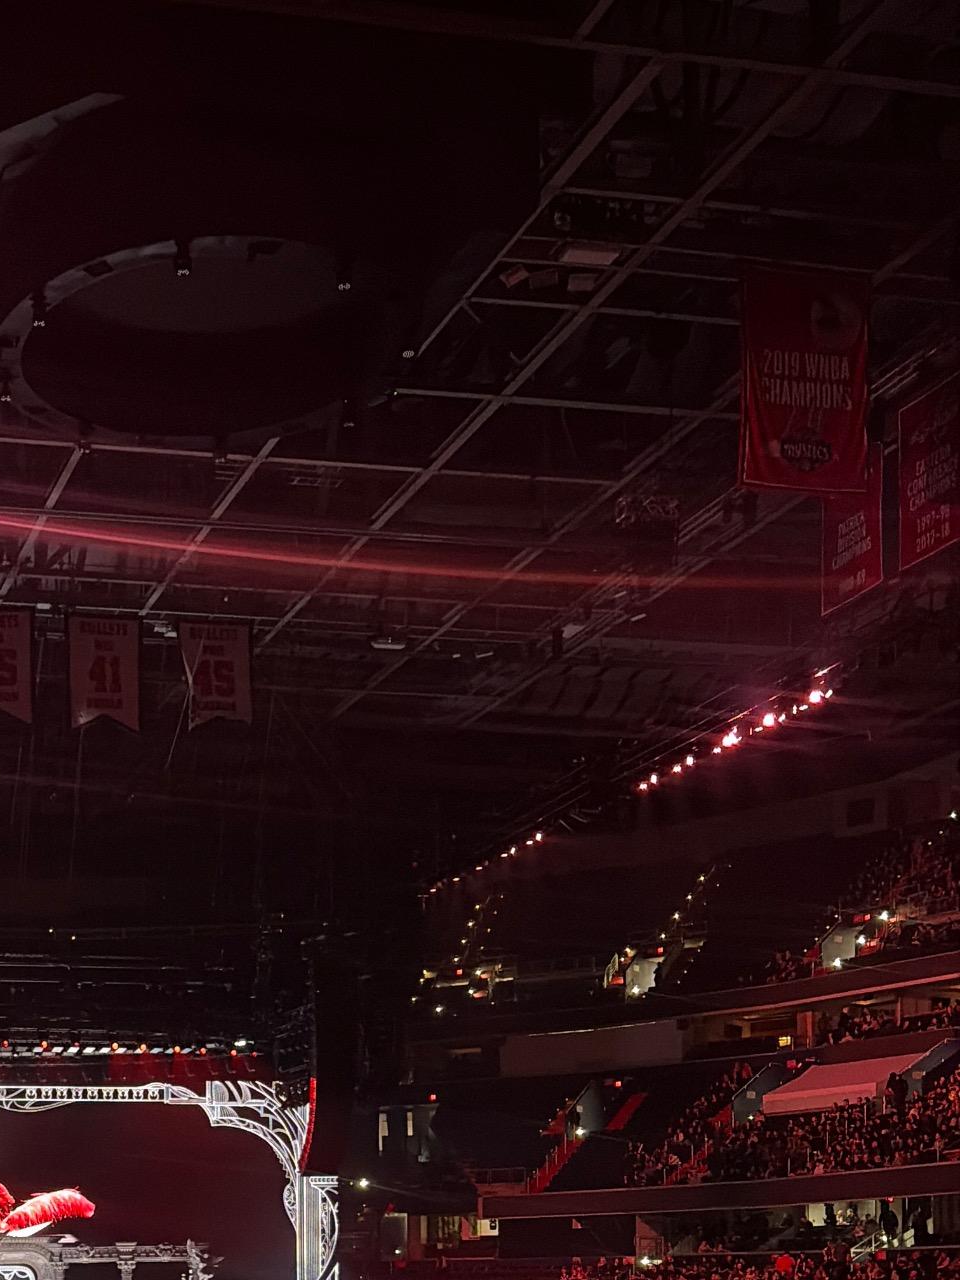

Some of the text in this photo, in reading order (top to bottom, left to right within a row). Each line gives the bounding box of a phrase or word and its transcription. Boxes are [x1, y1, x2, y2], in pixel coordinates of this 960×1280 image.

[763, 349, 850, 381] 2019 WNBA
[761, 378, 853, 411] CHAMPIONS
[88, 655, 123, 693] 41
[194, 659, 236, 698] 45
